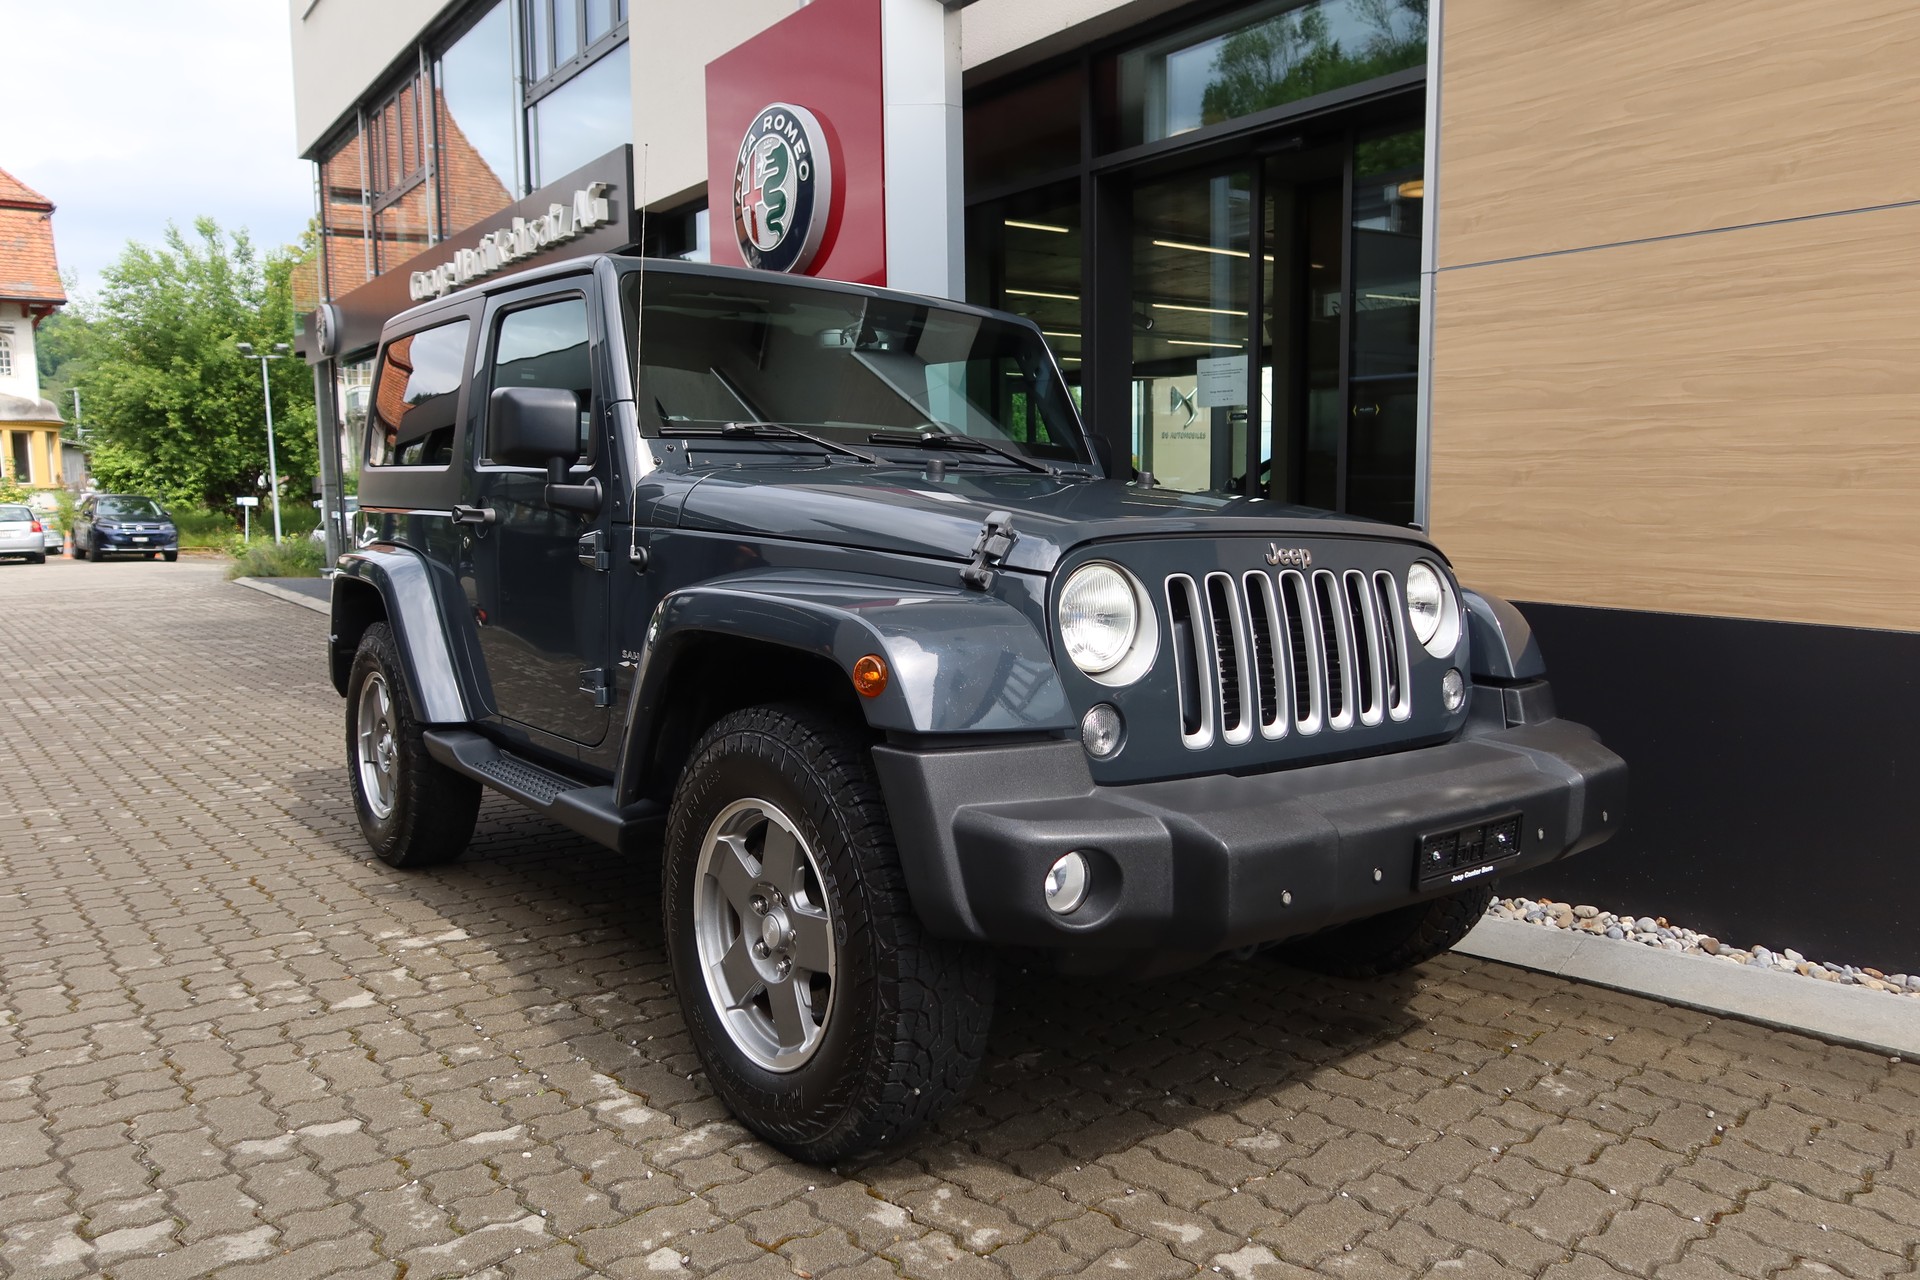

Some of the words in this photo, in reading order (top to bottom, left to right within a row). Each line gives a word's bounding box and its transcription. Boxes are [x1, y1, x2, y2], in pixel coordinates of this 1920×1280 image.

[735, 134, 756, 204] ALFA
[763, 115, 809, 181] ROMEO
[572, 181, 609, 233] AG
[1265, 542, 1312, 570] Jeep
[621, 649, 640, 661] SAH
[800, 807, 848, 947] KUMHO
[1464, 869, 1481, 878] Center
[1481, 865, 1493, 873] Bern
